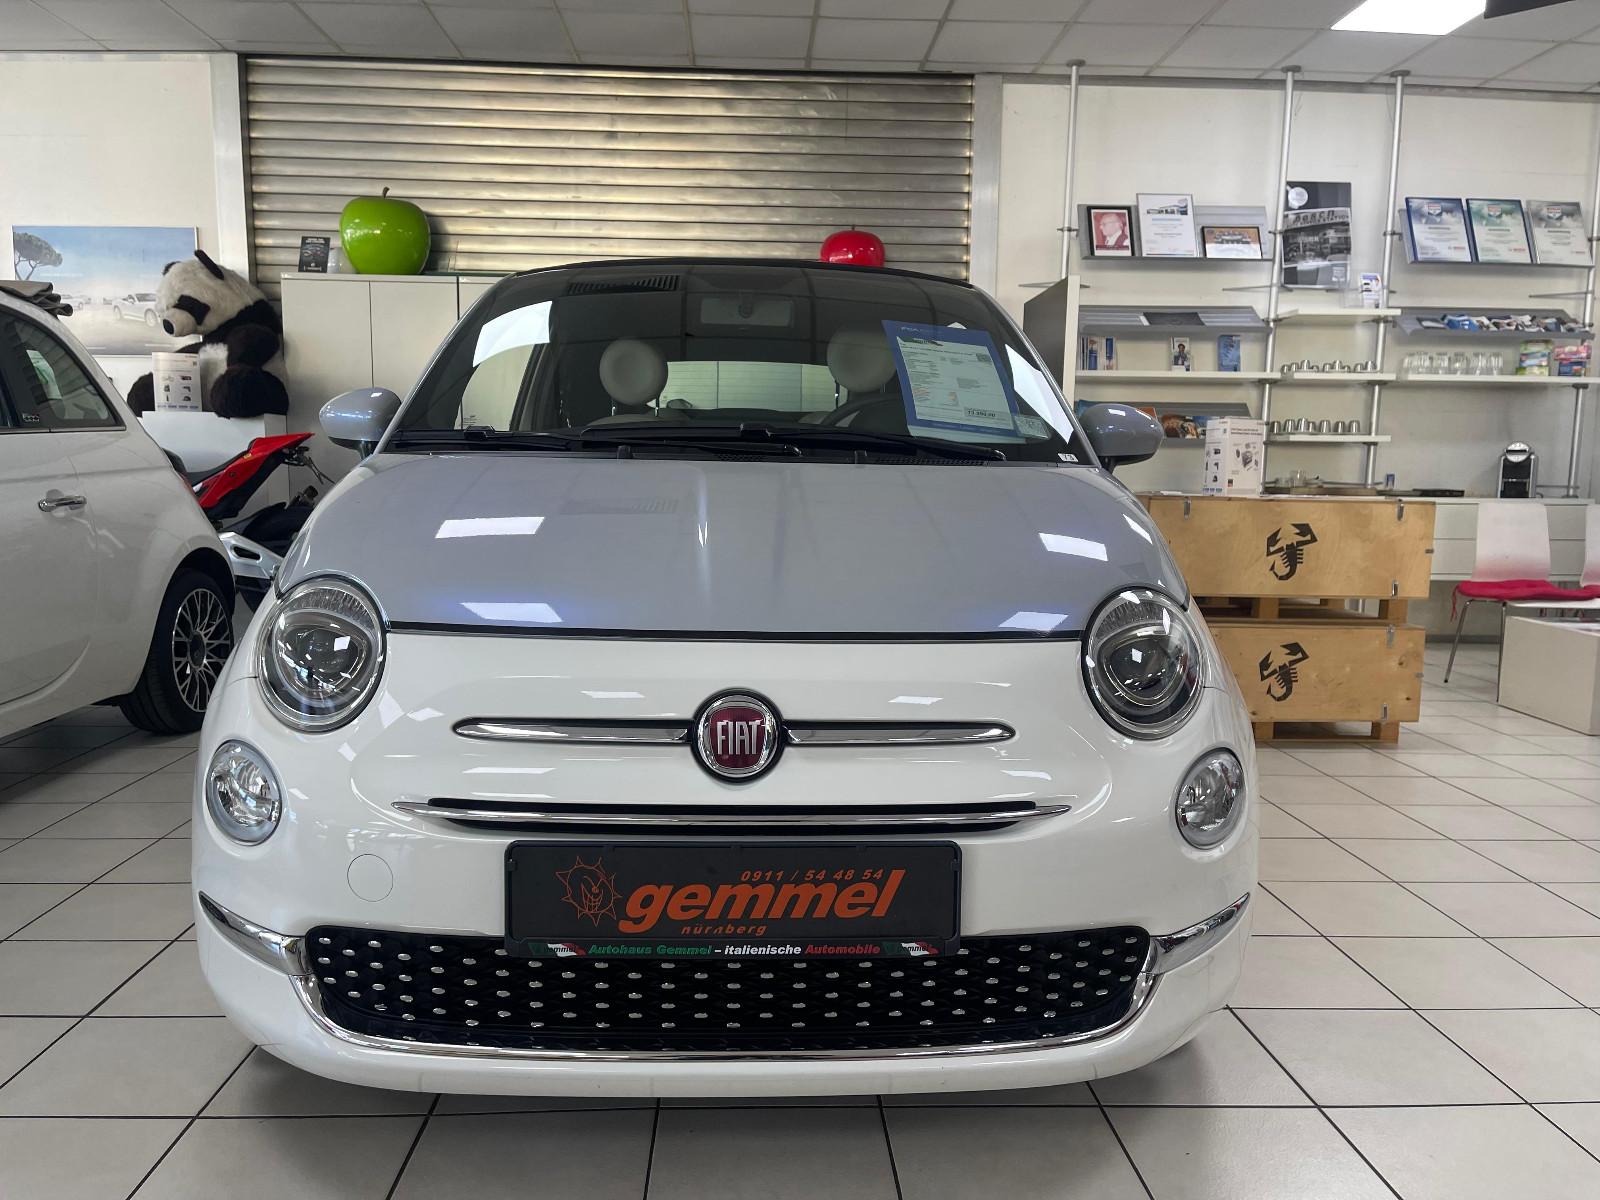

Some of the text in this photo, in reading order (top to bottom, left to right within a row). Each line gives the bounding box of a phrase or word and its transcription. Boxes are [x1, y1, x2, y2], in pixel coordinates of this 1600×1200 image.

[716, 720, 761, 755] FIAT
[740, 869, 883, 881] 0911 / 54 48 54
[618, 869, 906, 934] gemmel
[681, 923, 767, 936] nürnberg
[588, 944, 652, 955] Autohaus
[656, 945, 712, 955] Gemmel
[724, 945, 802, 955] italienische
[805, 944, 881, 954] Automobile
